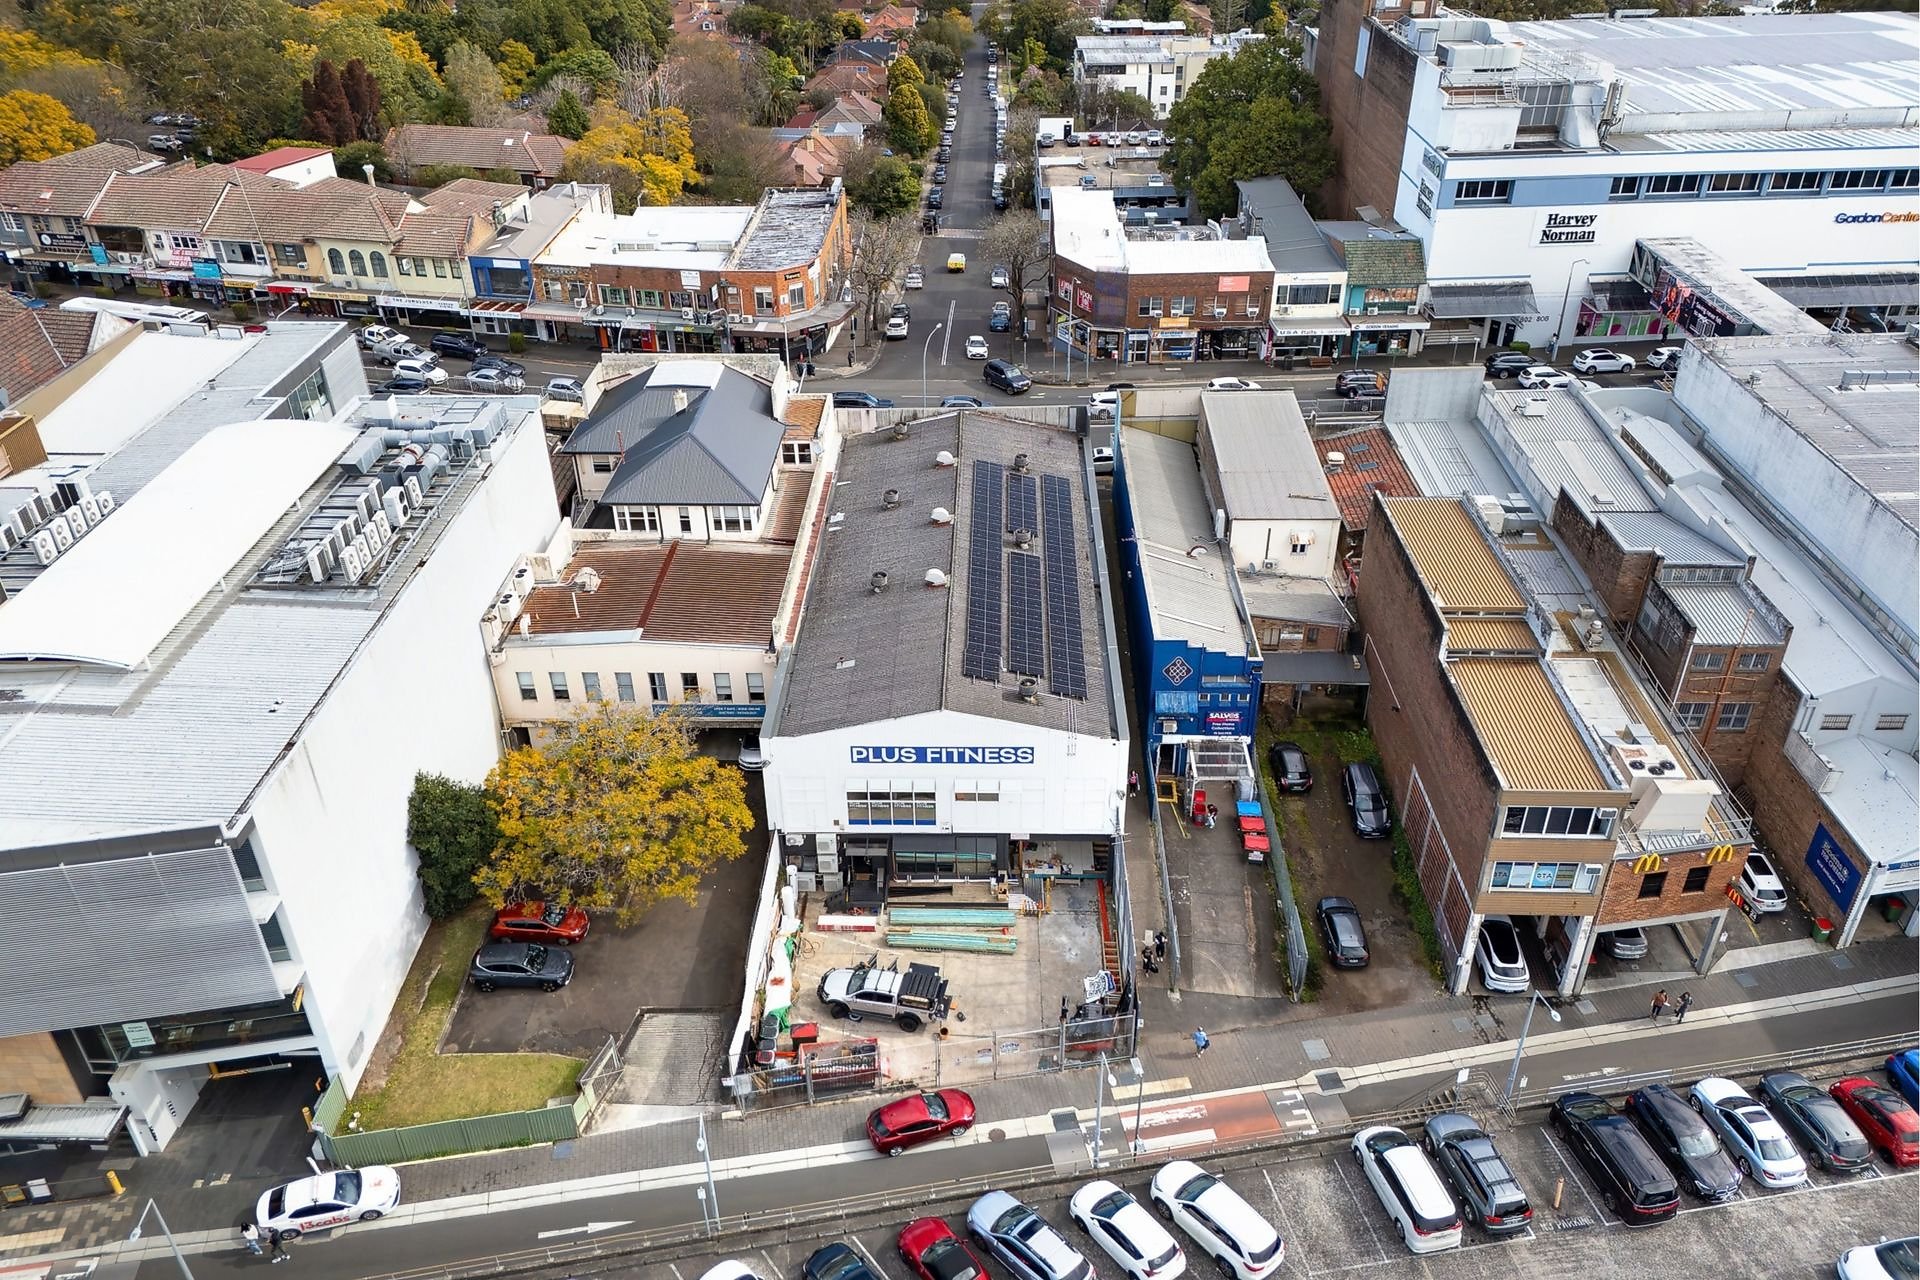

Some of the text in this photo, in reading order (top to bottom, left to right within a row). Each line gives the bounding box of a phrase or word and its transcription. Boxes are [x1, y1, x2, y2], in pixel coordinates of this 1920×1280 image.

[1546, 213, 1598, 228] Harvey
[1540, 229, 1596, 242] Norman
[852, 747, 1034, 763] PLUS FITNESS
[299, 1214, 350, 1232] 13cabs
[1555, 1215, 1595, 1230] PARKING
